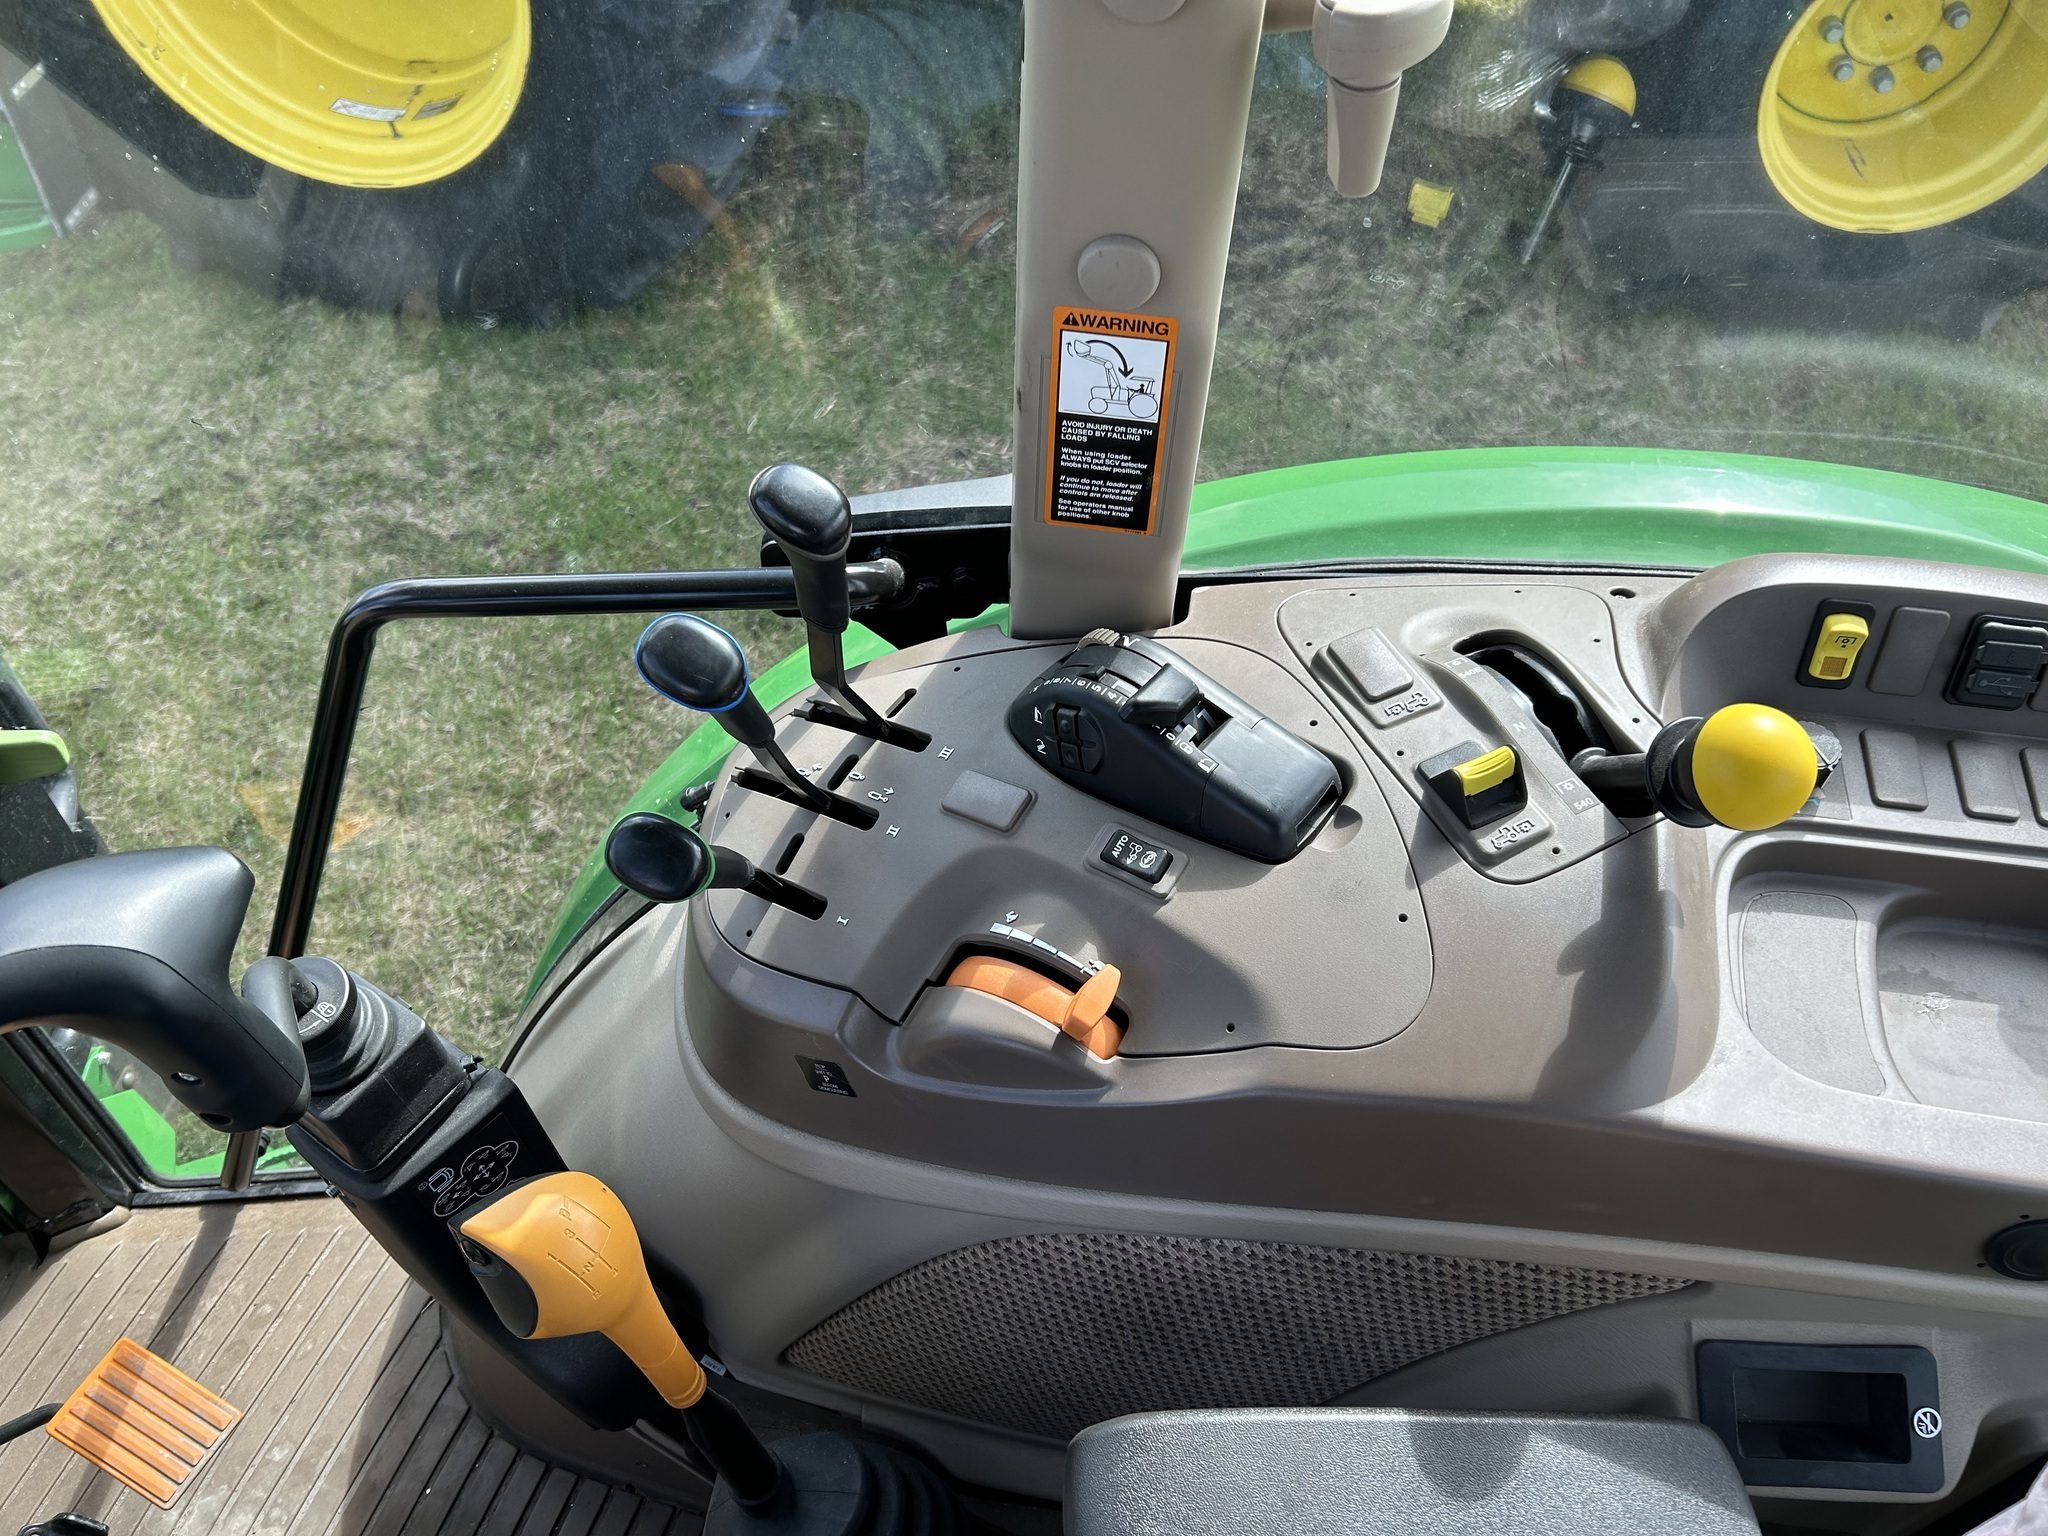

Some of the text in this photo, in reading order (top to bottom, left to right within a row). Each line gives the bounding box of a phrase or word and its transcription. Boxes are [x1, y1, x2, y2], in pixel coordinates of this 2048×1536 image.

[1080, 314, 1169, 336] WARNING
[1062, 420, 1085, 428] AVOID
[1086, 422, 1114, 432] INJURY
[1127, 427, 1153, 436] DEATH
[1061, 427, 1094, 436] CAUSED
[1108, 432, 1141, 442] FALLING
[1061, 434, 1088, 442] LOADS
[1061, 446, 1082, 455] When
[1108, 452, 1132, 461] loader
[1061, 455, 1092, 463] ALWAYS
[1121, 461, 1148, 470] selector
[1091, 464, 1112, 472] loader
[1113, 466, 1143, 476] position.
[1060, 482, 1090, 490] continue
[1106, 480, 1128, 489] loader
[1059, 488, 1088, 496] controls
[1102, 493, 1134, 502] released.
[1092, 508, 1110, 516] other
[1112, 510, 1130, 518] knob
[1108, 504, 1134, 512] manual
[1108, 692, 1117, 700] 4
[1513, 722, 1526, 731] N
[1574, 797, 1593, 810] 540
[1112, 835, 1129, 858] AUTO
[564, 1227, 576, 1239] 3
[583, 1261, 595, 1273] N
